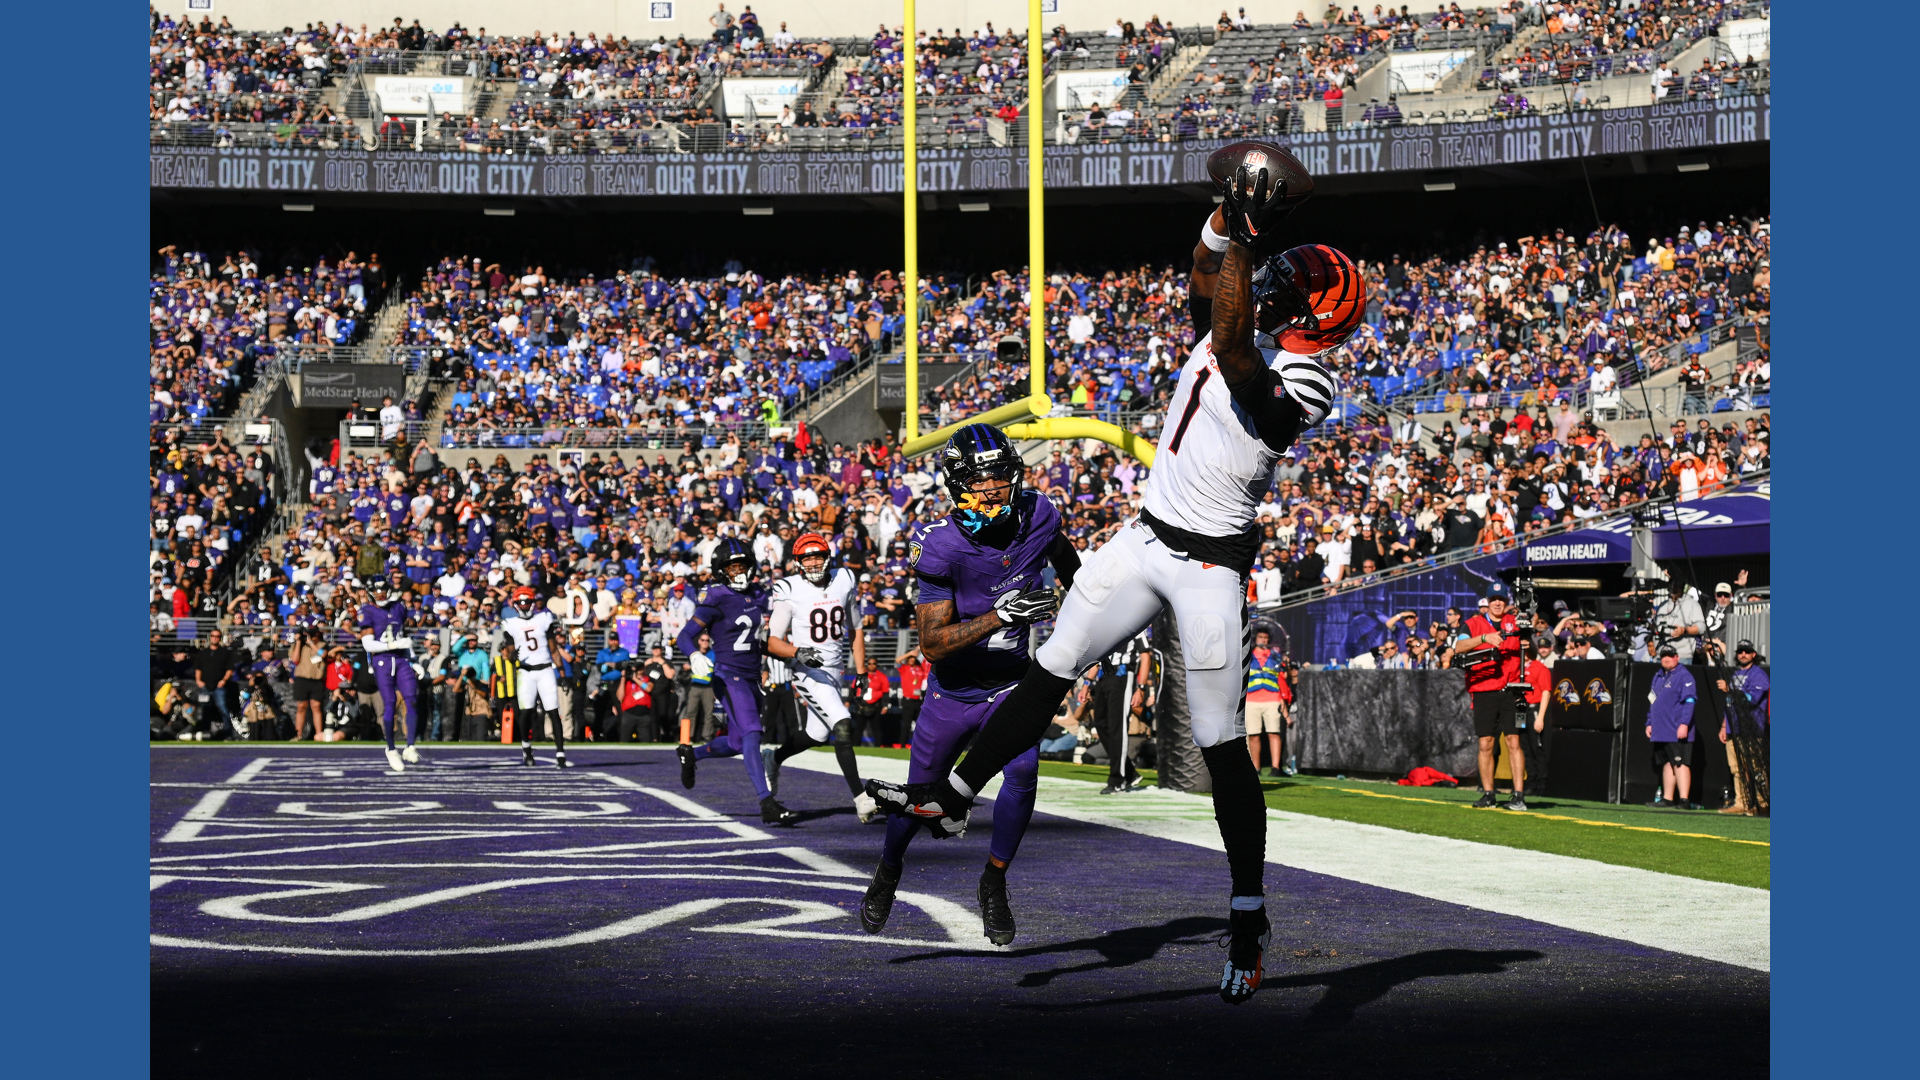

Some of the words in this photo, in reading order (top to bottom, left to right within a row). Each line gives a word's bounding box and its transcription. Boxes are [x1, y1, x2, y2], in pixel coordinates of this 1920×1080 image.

[218, 158, 261, 189] OUR
[266, 158, 318, 189] CITY.
[324, 160, 368, 191] OUR
[373, 161, 438, 192] TEAM.
[438, 163, 480, 194] OUR
[486, 163, 537, 194] CITY.
[543, 164, 587, 196] OUR
[591, 164, 654, 195] TEAM.
[655, 164, 696, 195] OUR
[702, 164, 751, 194] CITY.
[757, 163, 800, 195] OUR
[805, 163, 869, 195] TEAM.
[970, 159, 1012, 190] OUR
[1016, 157, 1079, 189] TAM.
[1081, 156, 1121, 187] OUR
[1128, 154, 1178, 185] CITY.
[1335, 140, 1385, 173] CITY.
[1390, 137, 1433, 171] OUR
[1438, 134, 1501, 168] TEAM.
[1502, 130, 1542, 163] OUR
[1549, 126, 1596, 158] CITY.
[1601, 120, 1644, 153] OUR
[1648, 115, 1714, 149] TEAM.
[1714, 111, 1756, 145] OUR
[304, 386, 352, 398] MedStar
[1168, 365, 1212, 456] 1
[1526, 545, 1568, 561] MEDSTAR
[1570, 543, 1608, 559] HEALTH
[990, 574, 1024, 592] RAVENS
[562, 590, 590, 625] D
[810, 605, 844, 643] 88
[525, 629, 538, 652] 5
